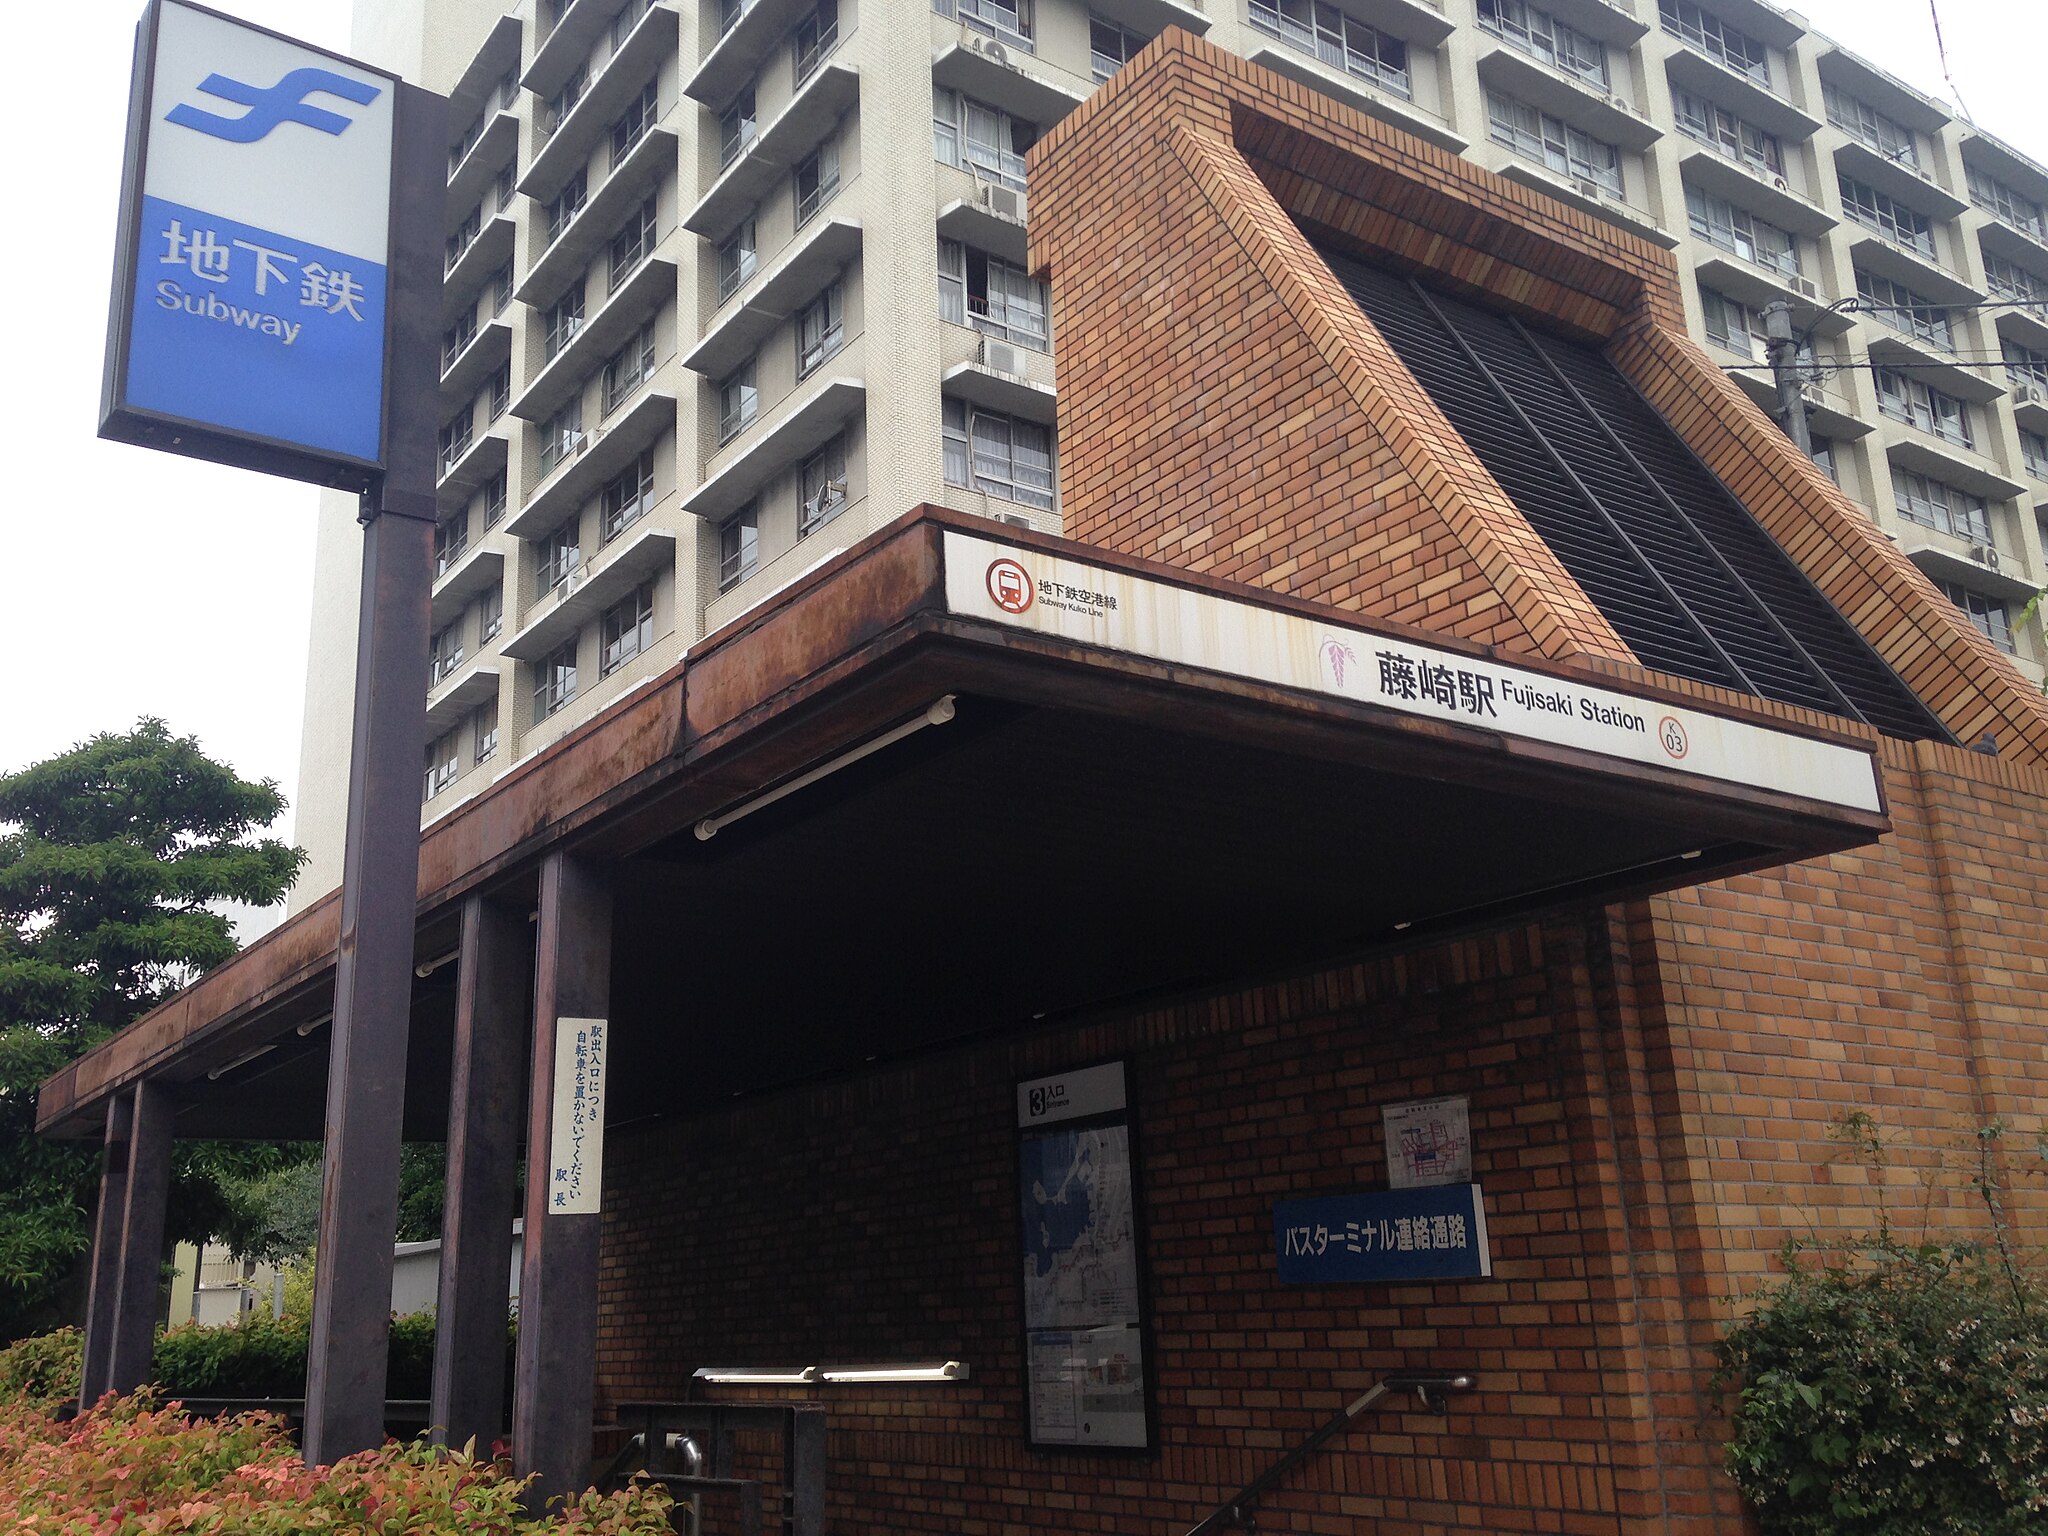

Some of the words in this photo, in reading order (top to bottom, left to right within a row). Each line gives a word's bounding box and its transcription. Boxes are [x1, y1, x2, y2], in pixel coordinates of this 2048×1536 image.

[160, 219, 365, 322] 地下鉄
[155, 280, 302, 345] Subway
[1038, 579, 1118, 611] 地下鉄空港線
[1038, 596, 1067, 611] Subway
[1068, 602, 1087, 614] Kuko
[1088, 607, 1104, 618] Line
[1376, 650, 1497, 718] 藤崎駅
[1501, 678, 1573, 717] Fujisaki
[1580, 697, 1646, 733] Station
[1665, 734, 1684, 753] 03
[1668, 721, 1677, 735] K
[588, 1025, 603, 1121] 駅出入口につき
[1046, 1085, 1065, 1100] 入口
[570, 1030, 588, 1199] 自転車を置かないでください
[1031, 1088, 1044, 1115] 3
[554, 1168, 568, 1206] 駅長
[1284, 1213, 1467, 1256] バスターミナル連絡通路
